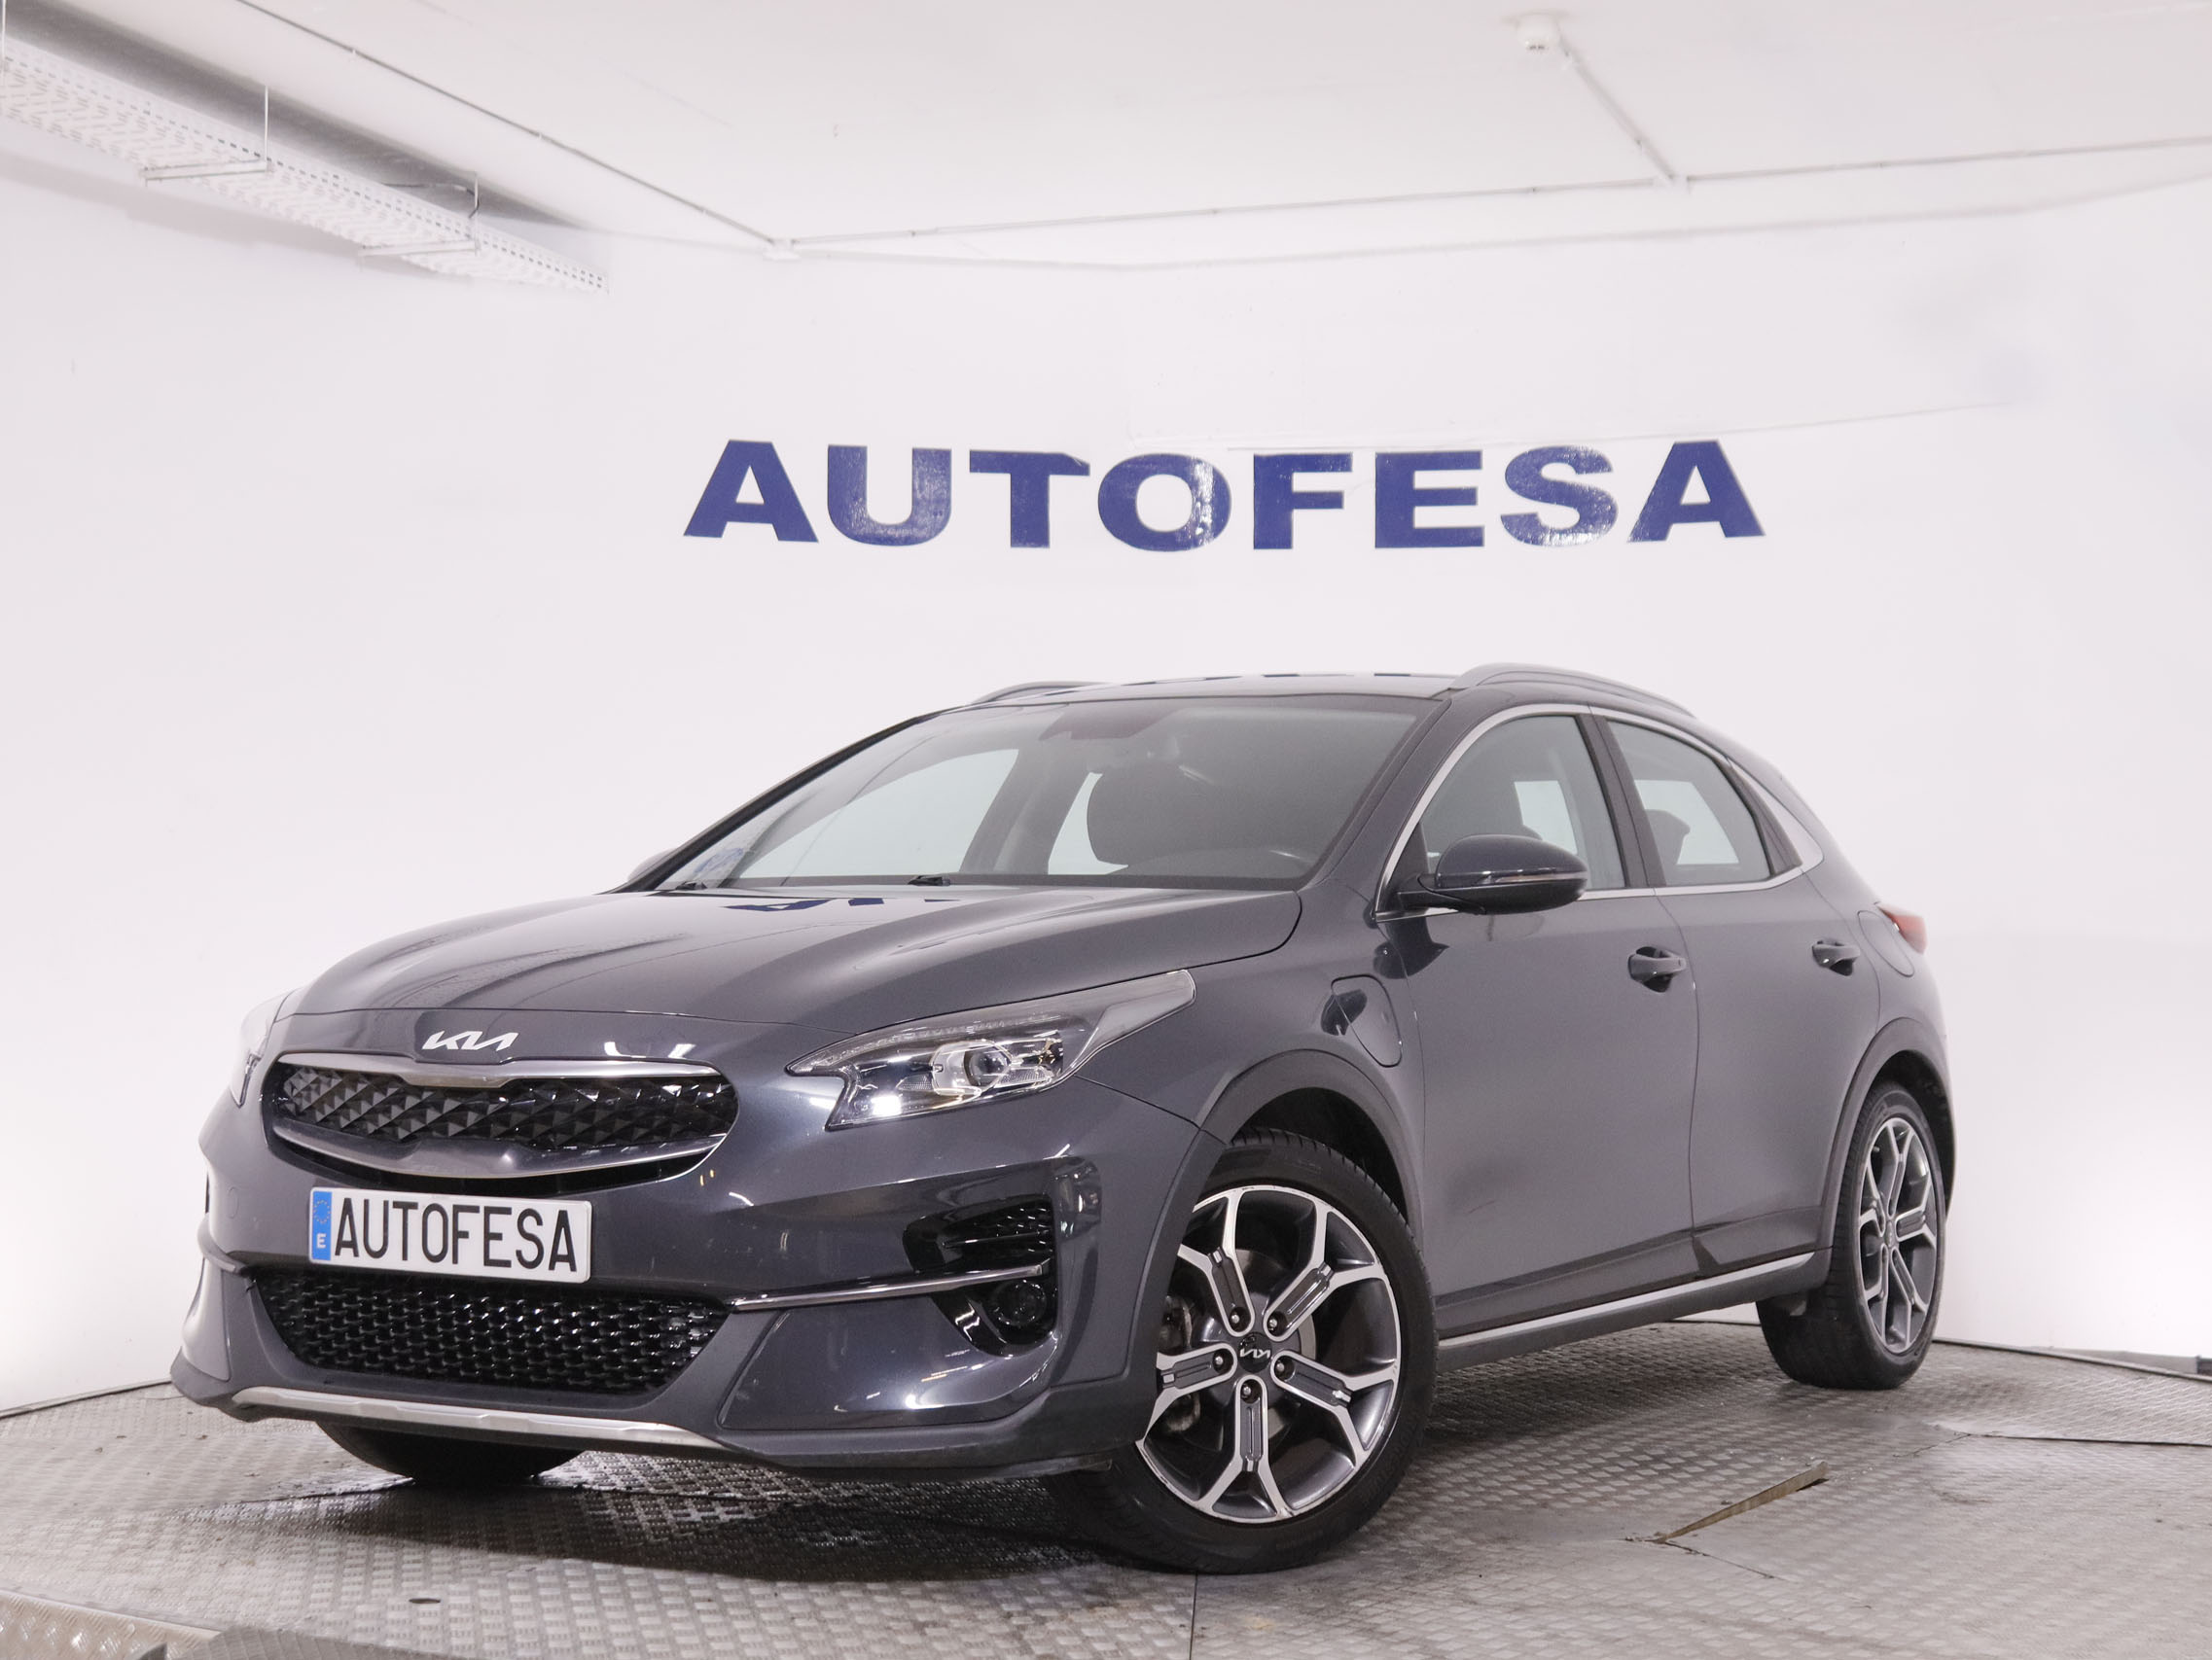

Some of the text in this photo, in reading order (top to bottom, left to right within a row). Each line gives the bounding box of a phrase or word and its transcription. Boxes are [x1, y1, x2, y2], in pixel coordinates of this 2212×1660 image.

[684, 439, 1766, 552] AUTOFESA
[422, 1031, 519, 1051] KIA
[317, 1197, 577, 1272] E AUTOFESA
